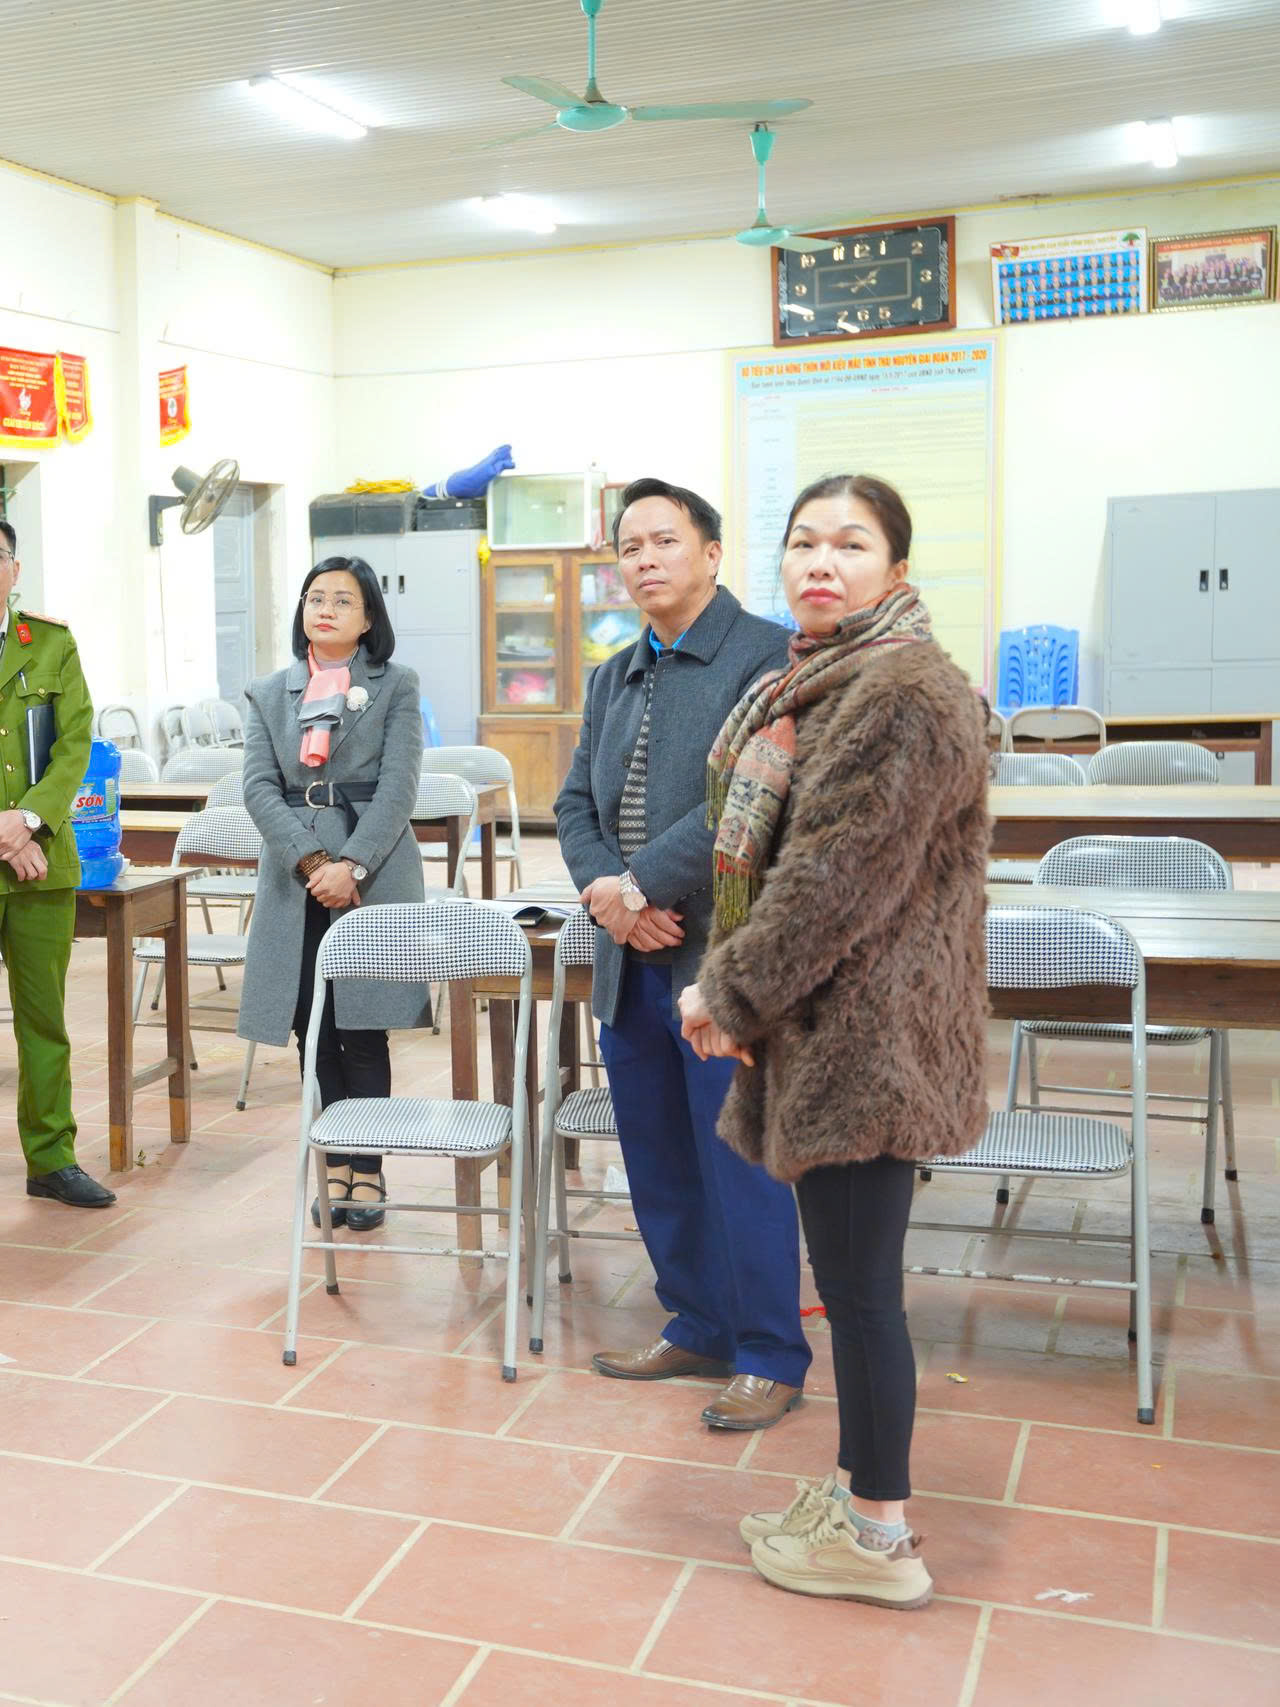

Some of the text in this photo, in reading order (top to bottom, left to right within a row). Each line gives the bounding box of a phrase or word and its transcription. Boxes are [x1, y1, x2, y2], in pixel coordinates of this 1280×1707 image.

[911, 240, 923, 255] 2
[920, 268, 932, 283] 3
[912, 296, 922, 311] 4
[857, 310, 870, 321] 6
[878, 306, 891, 320] 5
